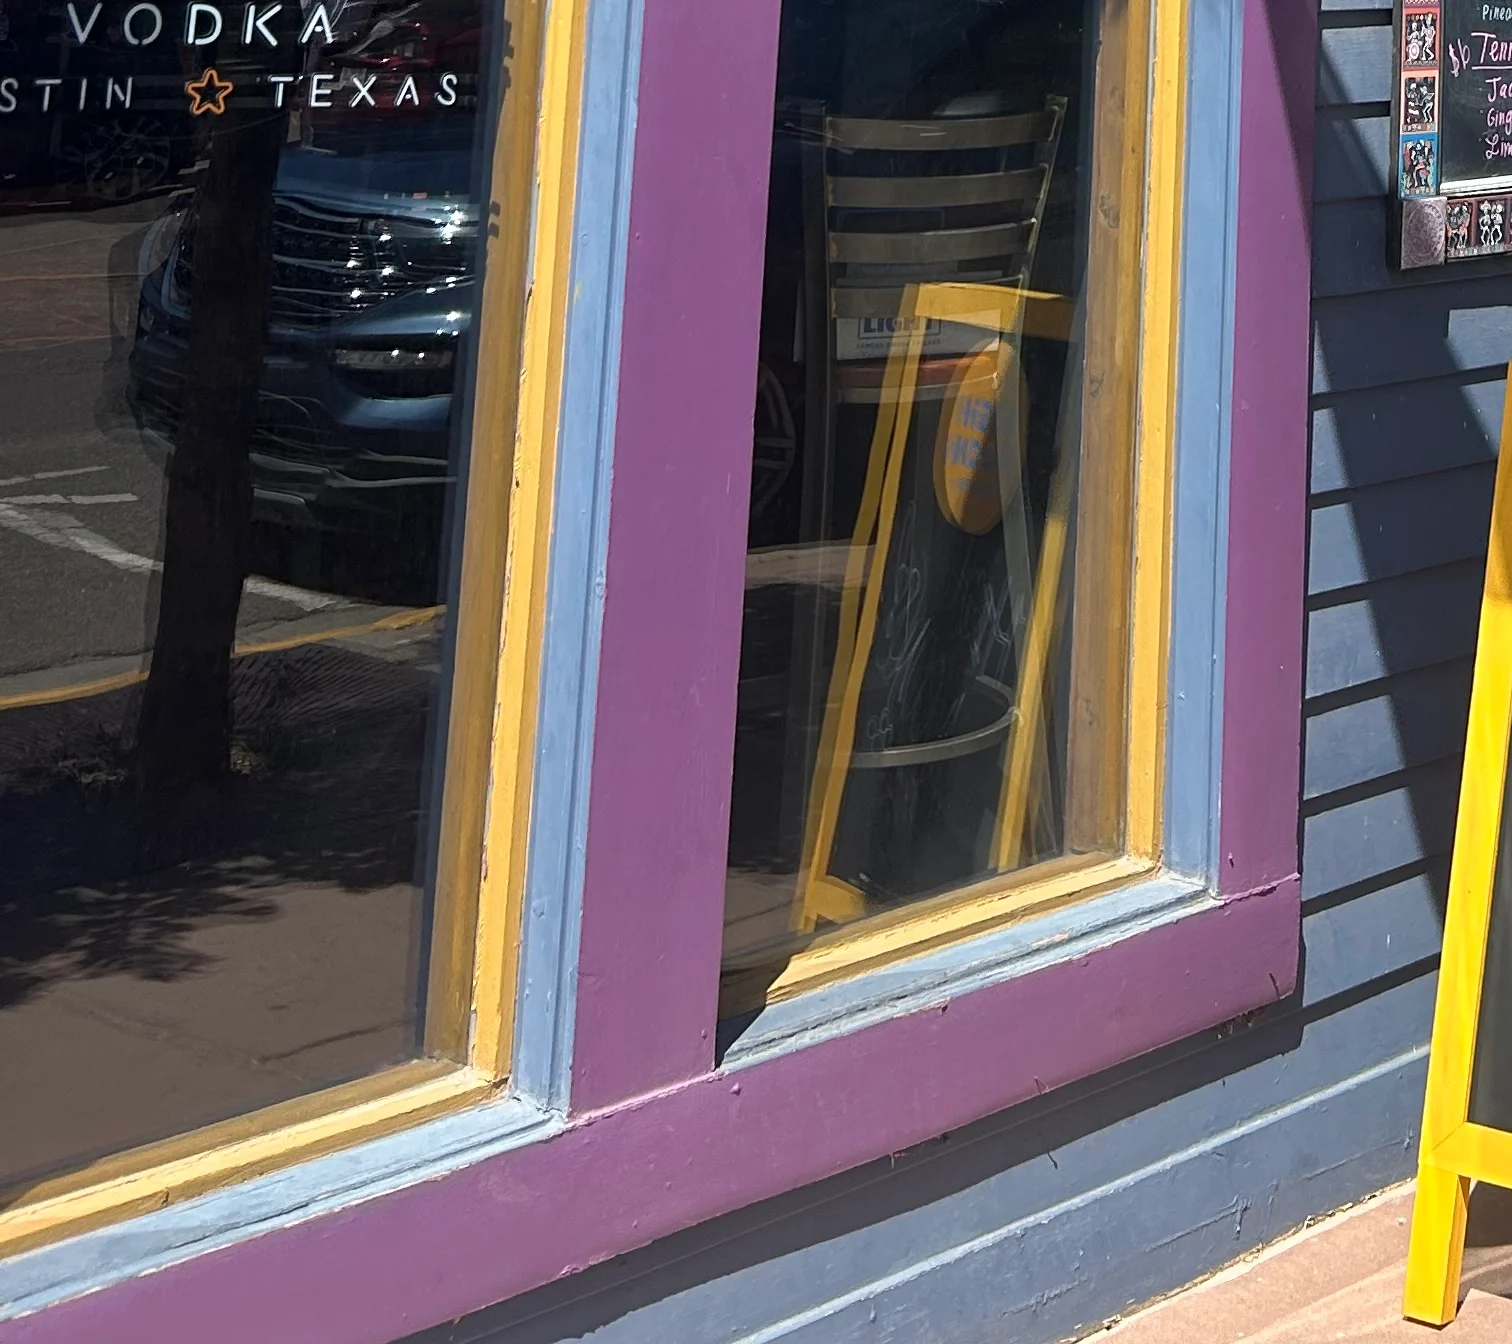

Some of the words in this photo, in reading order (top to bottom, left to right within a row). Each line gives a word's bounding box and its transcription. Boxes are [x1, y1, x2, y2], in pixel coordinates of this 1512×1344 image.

[67, 2, 334, 46] VODKA
[0, 76, 133, 110] STIN
[267, 73, 458, 108] TEXAS
